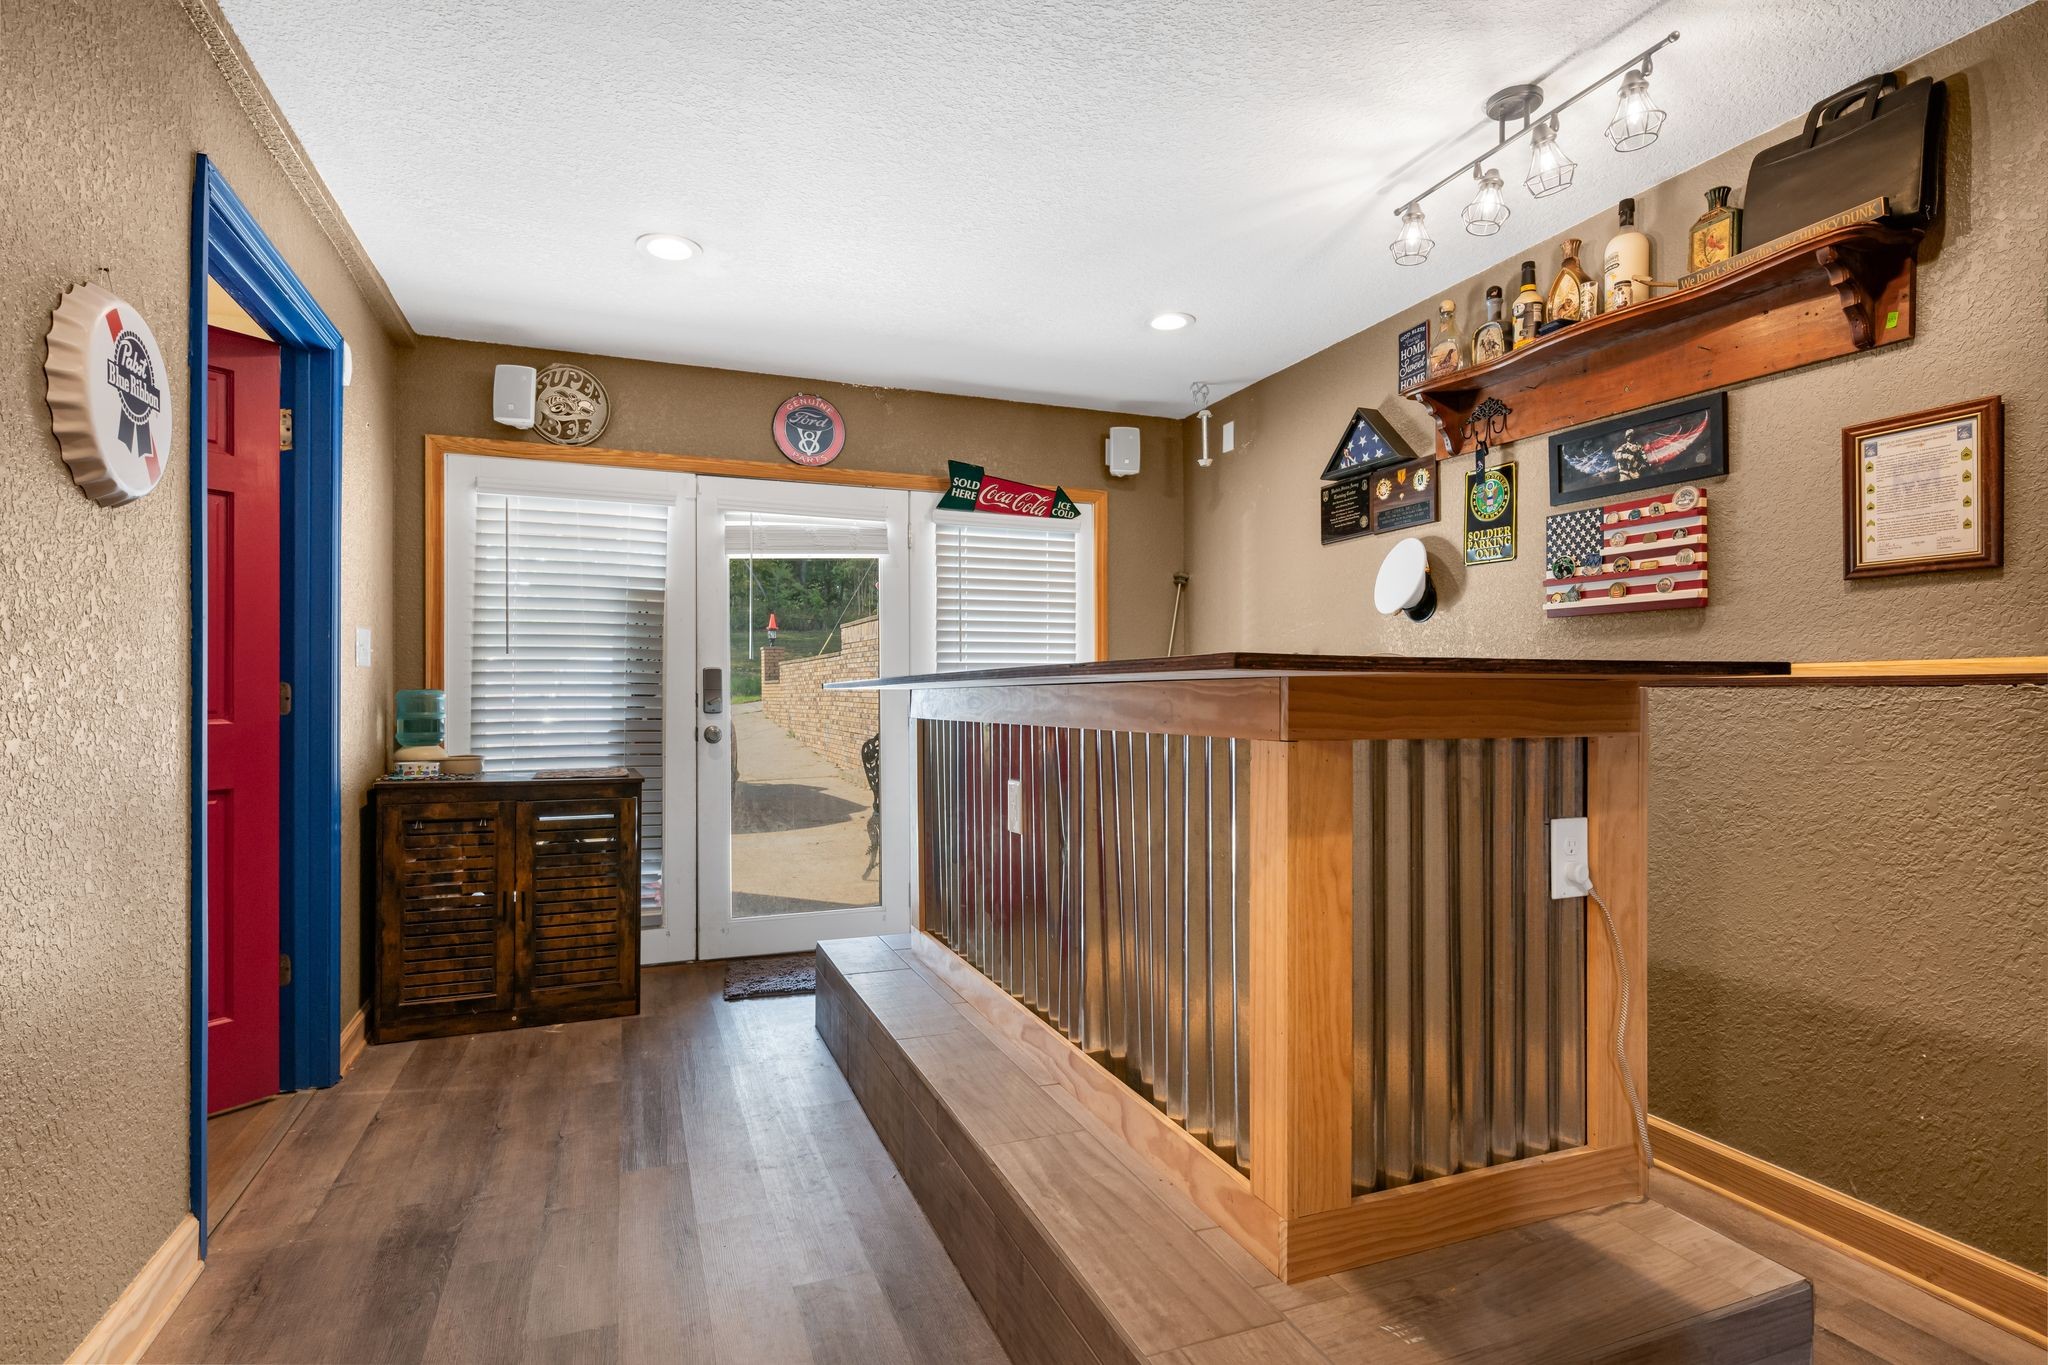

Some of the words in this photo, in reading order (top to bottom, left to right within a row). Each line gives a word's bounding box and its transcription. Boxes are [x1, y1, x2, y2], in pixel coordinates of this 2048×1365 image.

[1681, 278, 1695, 289] We
[1697, 267, 1720, 283] Don't
[1722, 253, 1754, 273] skinny
[1793, 218, 1840, 245] CHUNKY
[1842, 204, 1878, 226] DUNK
[1401, 340, 1426, 361] HOME
[119, 340, 148, 379] Pabst
[1400, 355, 1426, 377] Sweet
[108, 361, 130, 393] Blue
[130, 374, 160, 410] Ribbon
[537, 369, 601, 405] SUPER
[1401, 372, 1426, 390] HOME
[786, 398, 833, 415] GENUINE
[789, 411, 829, 428] Ford
[792, 451, 828, 463] PARTS
[952, 477, 981, 491] SOLD
[951, 488, 977, 501] HERE
[979, 484, 1052, 517] Coca-Cola
[1052, 508, 1075, 519] COLD
[1057, 501, 1072, 511] ICE
[1468, 525, 1511, 541] SOLDIER
[1467, 536, 1511, 551] PARKING
[1476, 547, 1503, 560] ONLY
